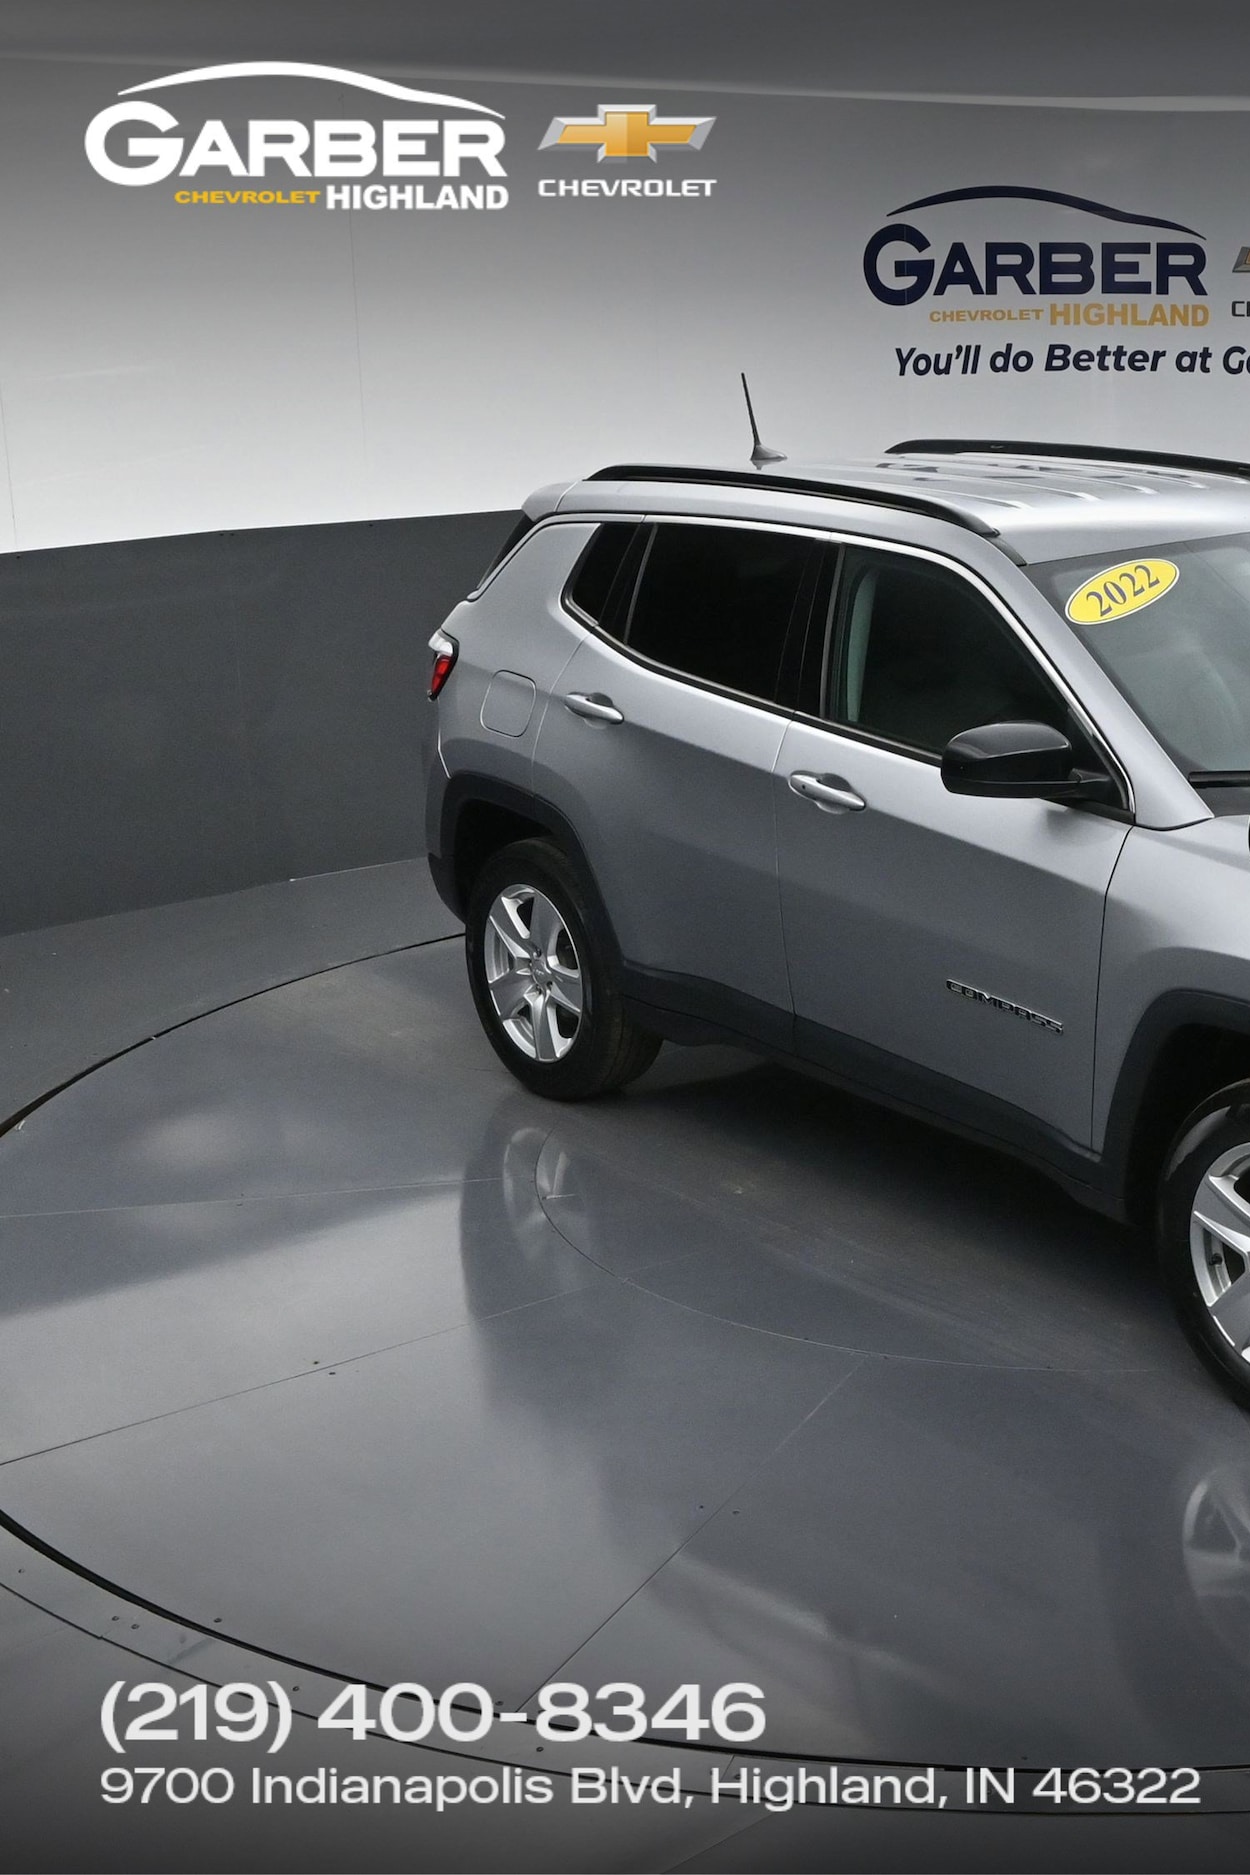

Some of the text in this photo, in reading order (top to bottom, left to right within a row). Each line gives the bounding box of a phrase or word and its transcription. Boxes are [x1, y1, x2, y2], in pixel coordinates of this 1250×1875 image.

[863, 223, 1208, 306] GARBER
[929, 303, 1210, 327] CHEVROLET HIGHLAND
[895, 345, 981, 376] You'll
[989, 343, 1034, 372] do
[1044, 344, 1167, 372] Better
[1175, 346, 1213, 374] at
[1086, 564, 1160, 617] 2022
